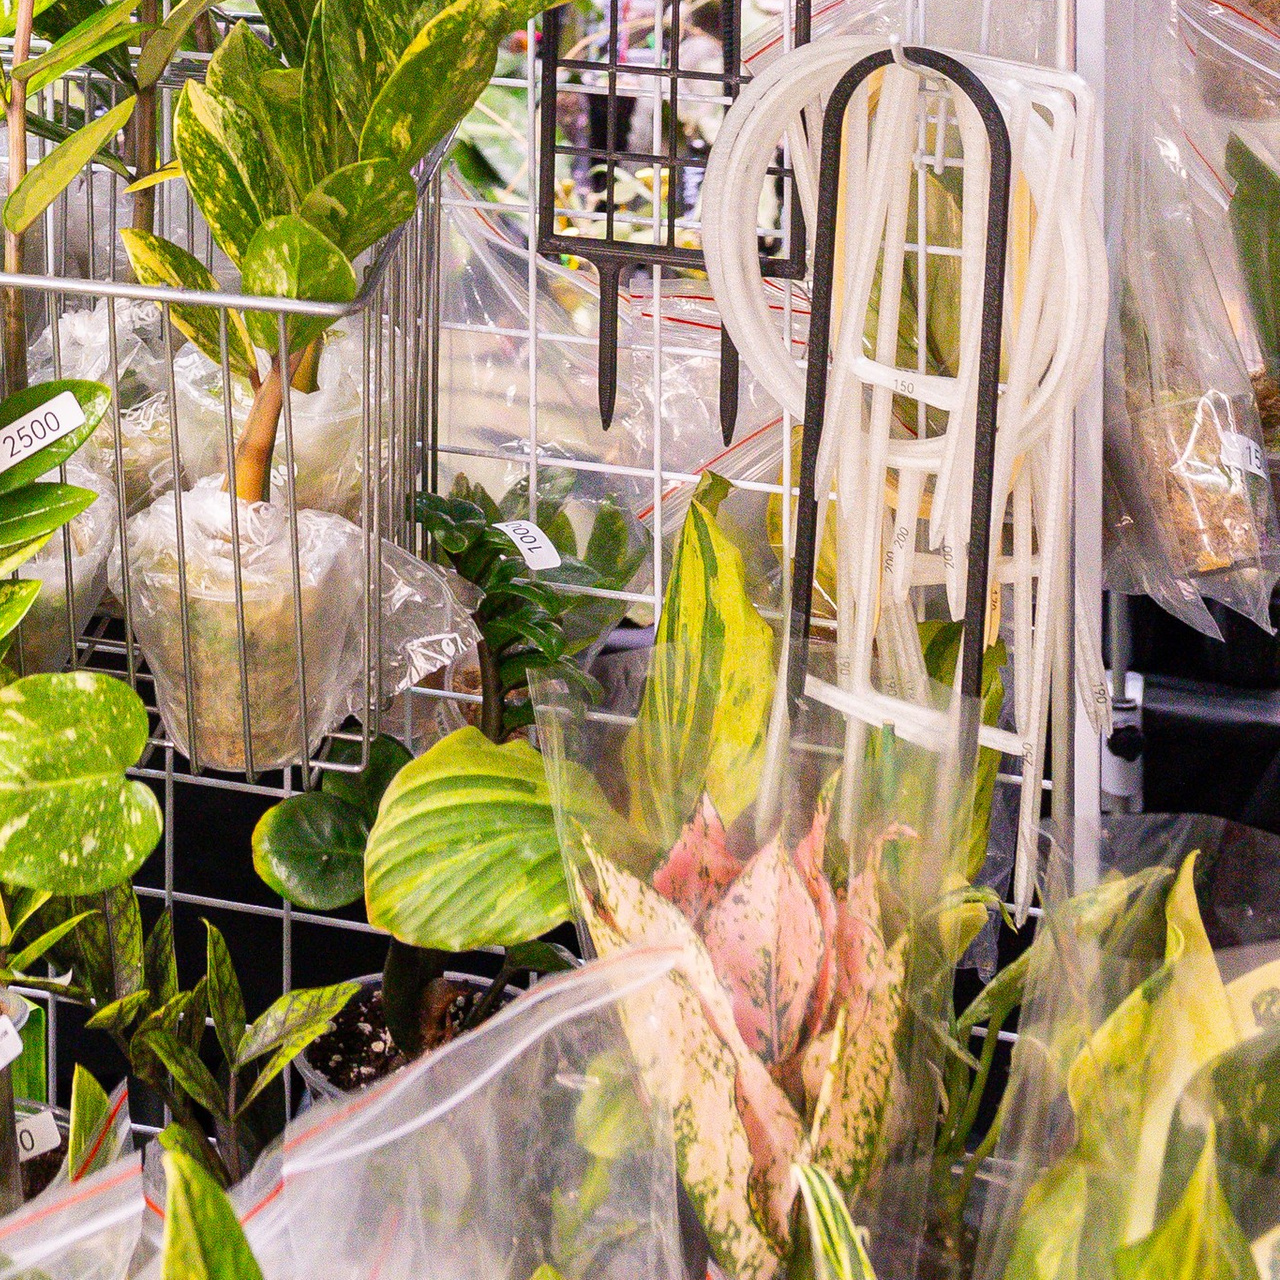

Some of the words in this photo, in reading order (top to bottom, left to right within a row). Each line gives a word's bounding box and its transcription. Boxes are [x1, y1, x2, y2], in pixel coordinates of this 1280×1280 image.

[894, 378, 915, 395] 150
[2, 411, 61, 459] 2500
[504, 522, 542, 554] 1000
[894, 526, 910, 550] 200
[884, 550, 895, 575] 200
[942, 545, 955, 570] 200
[1092, 681, 1108, 704] 190
[1022, 742, 1033, 766] 250
